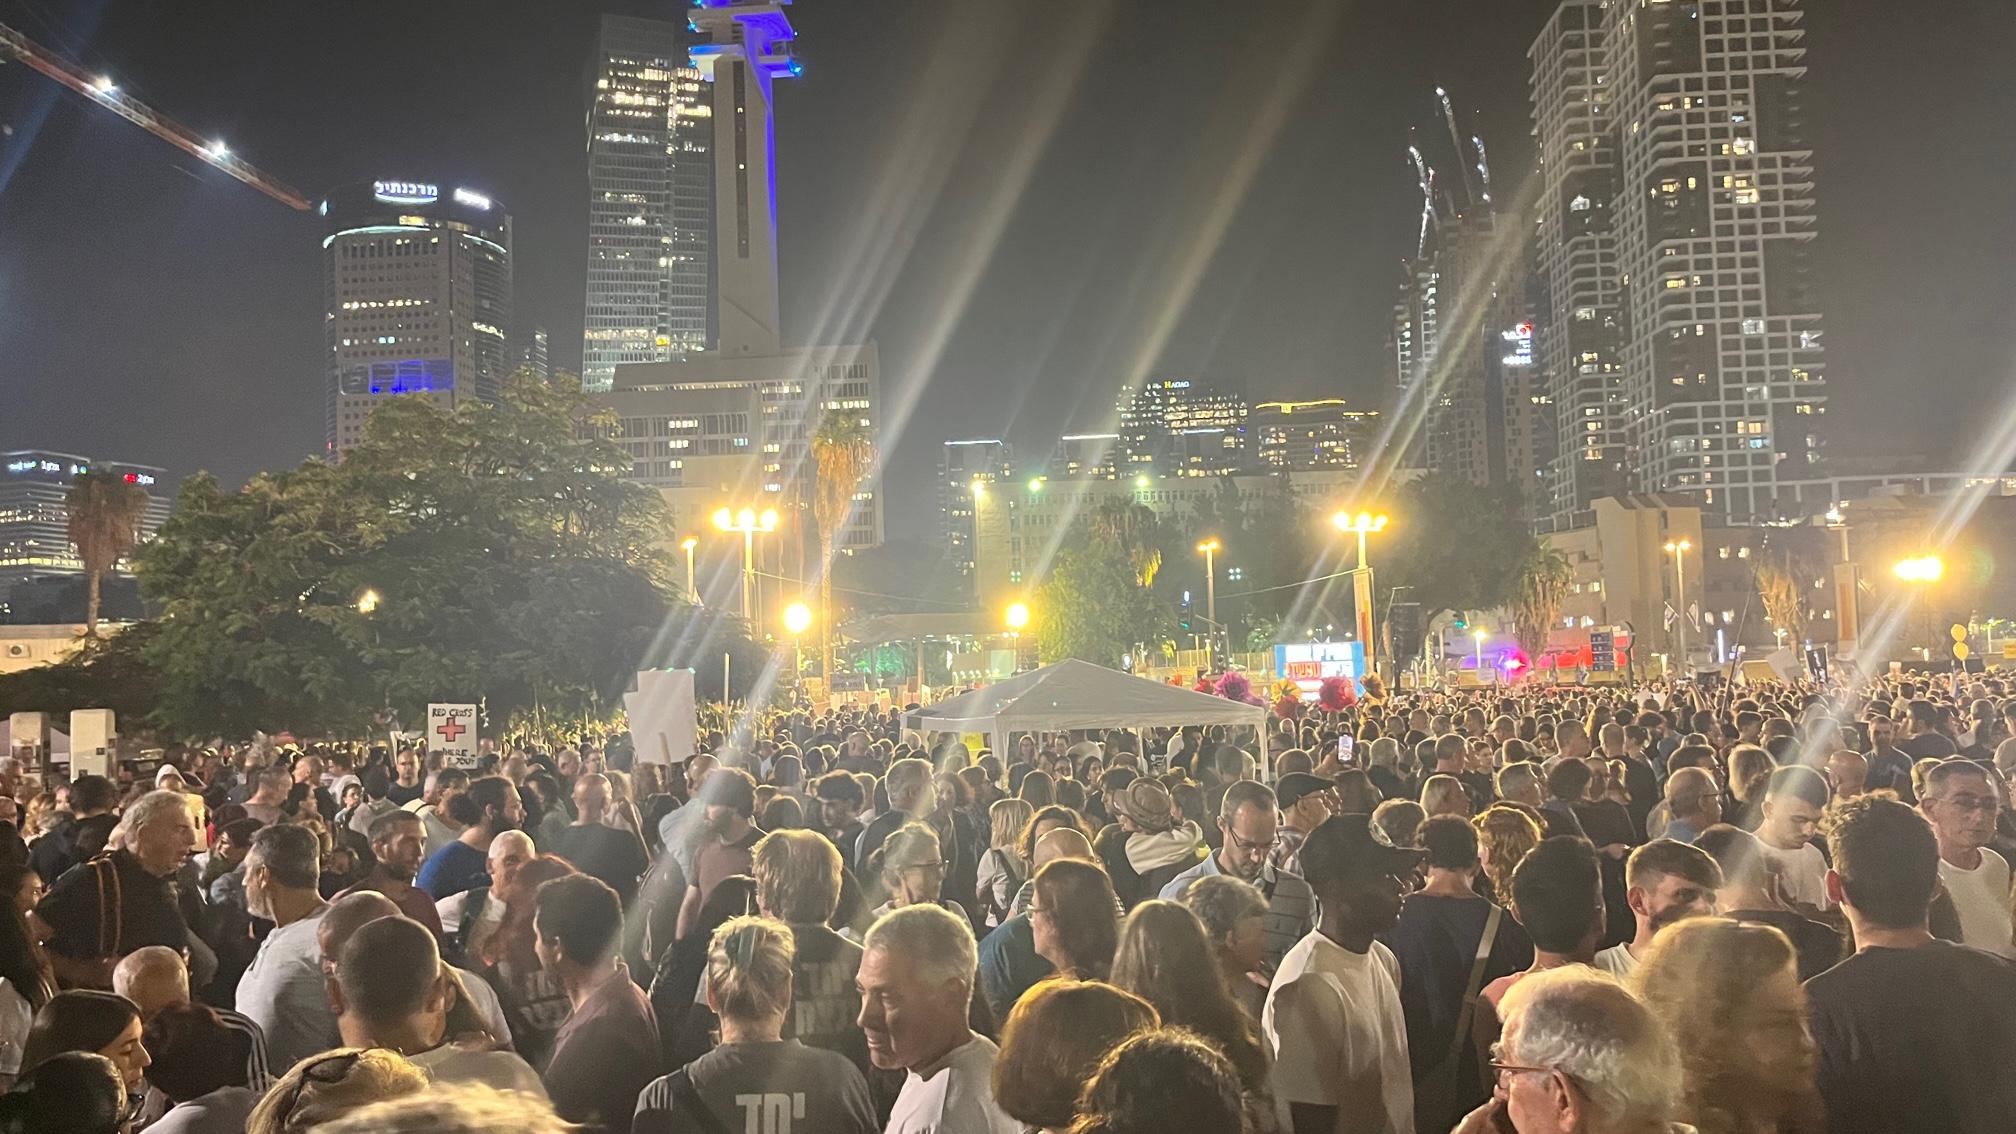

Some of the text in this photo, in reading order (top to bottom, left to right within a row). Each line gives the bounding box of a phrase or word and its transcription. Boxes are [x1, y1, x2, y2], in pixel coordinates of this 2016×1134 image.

[374, 181, 438, 196] מרכנתיל
[432, 708, 473, 717] RED CROSS
